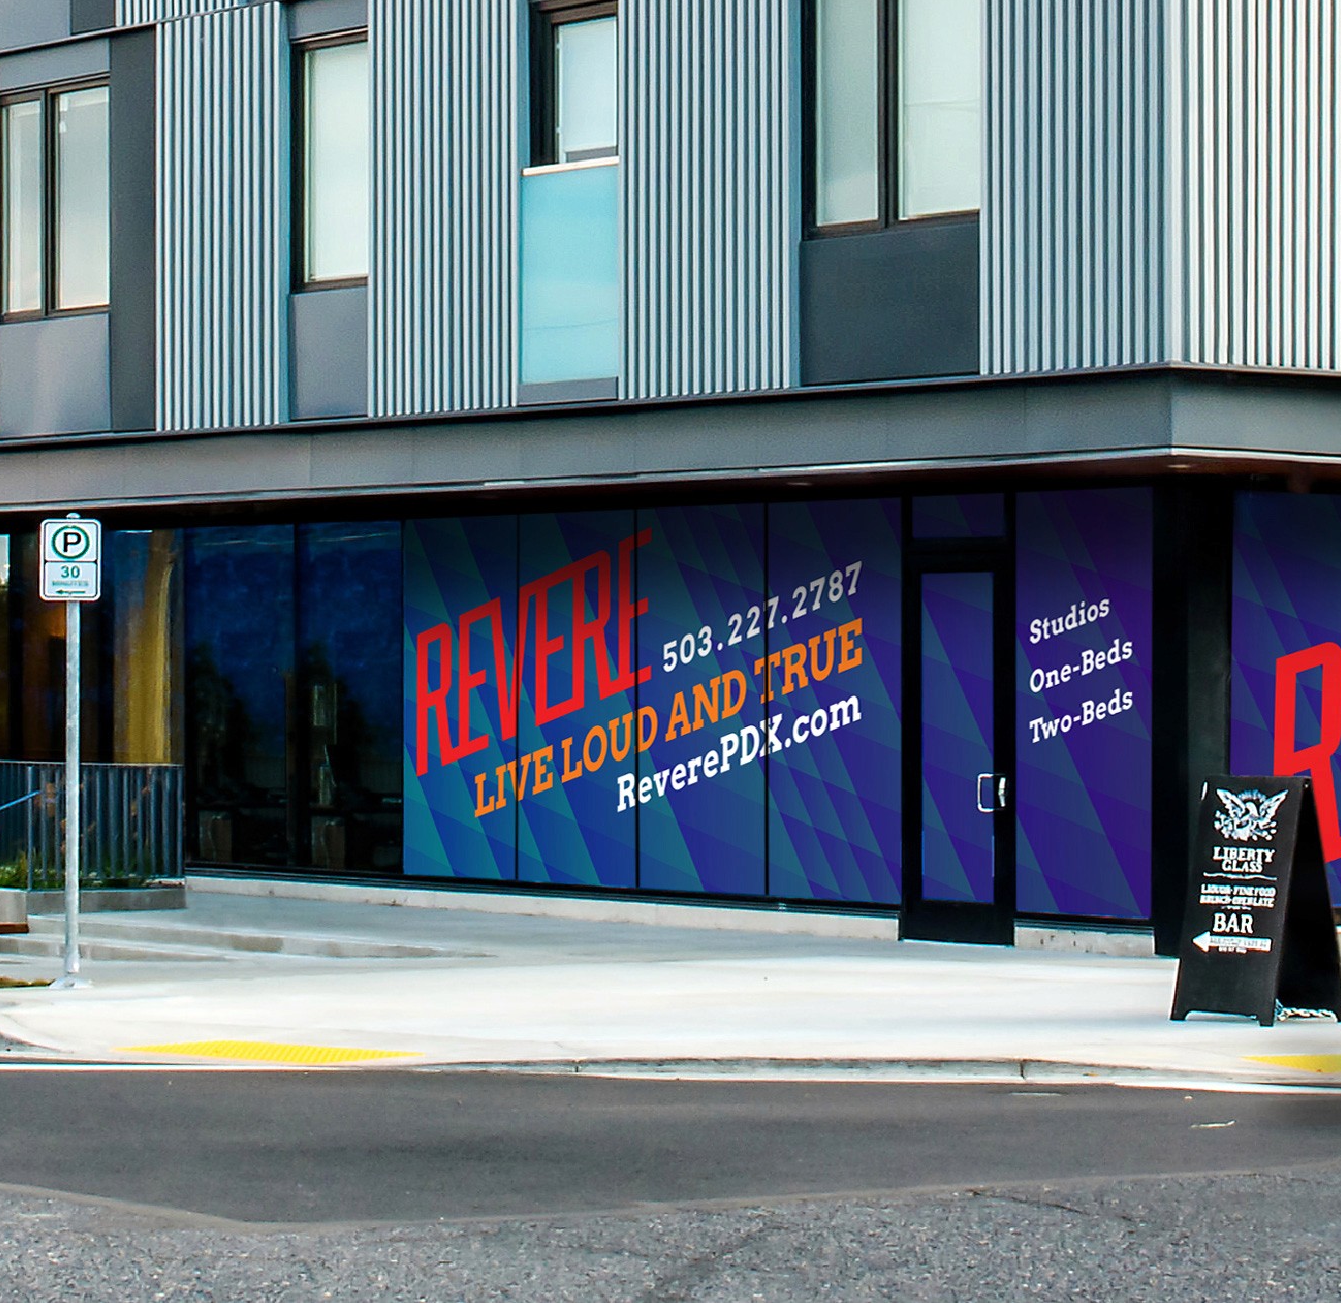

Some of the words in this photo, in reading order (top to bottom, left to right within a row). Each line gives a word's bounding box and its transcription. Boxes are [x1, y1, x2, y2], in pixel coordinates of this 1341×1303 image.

[63, 532, 82, 553] P
[60, 565, 80, 579] 30
[662, 560, 863, 673] 503.227.2787
[1029, 597, 1110, 645] Studios
[416, 527, 652, 777] REVERE
[1029, 638, 1134, 694] One-Beds
[474, 744, 554, 818] LIVE
[562, 705, 658, 784] LOUD
[665, 669, 747, 741] AND
[754, 617, 863, 703] TRUE
[1029, 688, 1134, 745] Two-Beds
[617, 695, 863, 813] ReverePDX.com
[1213, 846, 1276, 863] LIBERTY
[1222, 859, 1263, 873] GLASS
[1213, 911, 1254, 934] BAR
